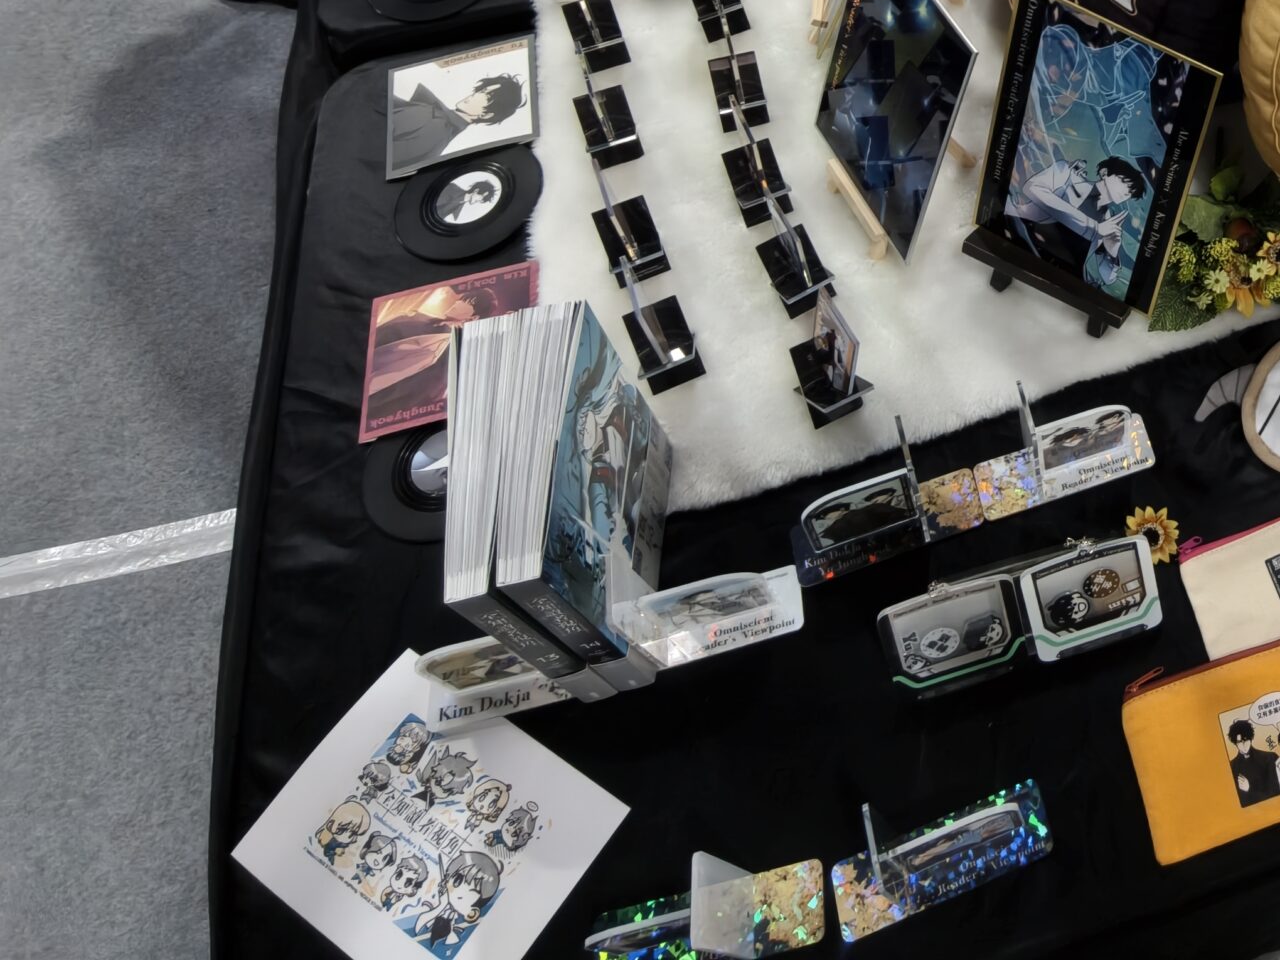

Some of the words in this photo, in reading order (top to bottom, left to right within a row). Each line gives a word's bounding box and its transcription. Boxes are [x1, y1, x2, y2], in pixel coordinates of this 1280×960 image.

[1004, 72, 1024, 121] Reader's
[993, 124, 1015, 182] Viewpoint
[1152, 210, 1168, 232] Kim
[369, 402, 444, 429] Junghyeok
[699, 635, 738, 653] eader's
[742, 617, 796, 640] Viewpoint
[438, 705, 474, 722] Kim
[479, 689, 531, 713] Dokja
